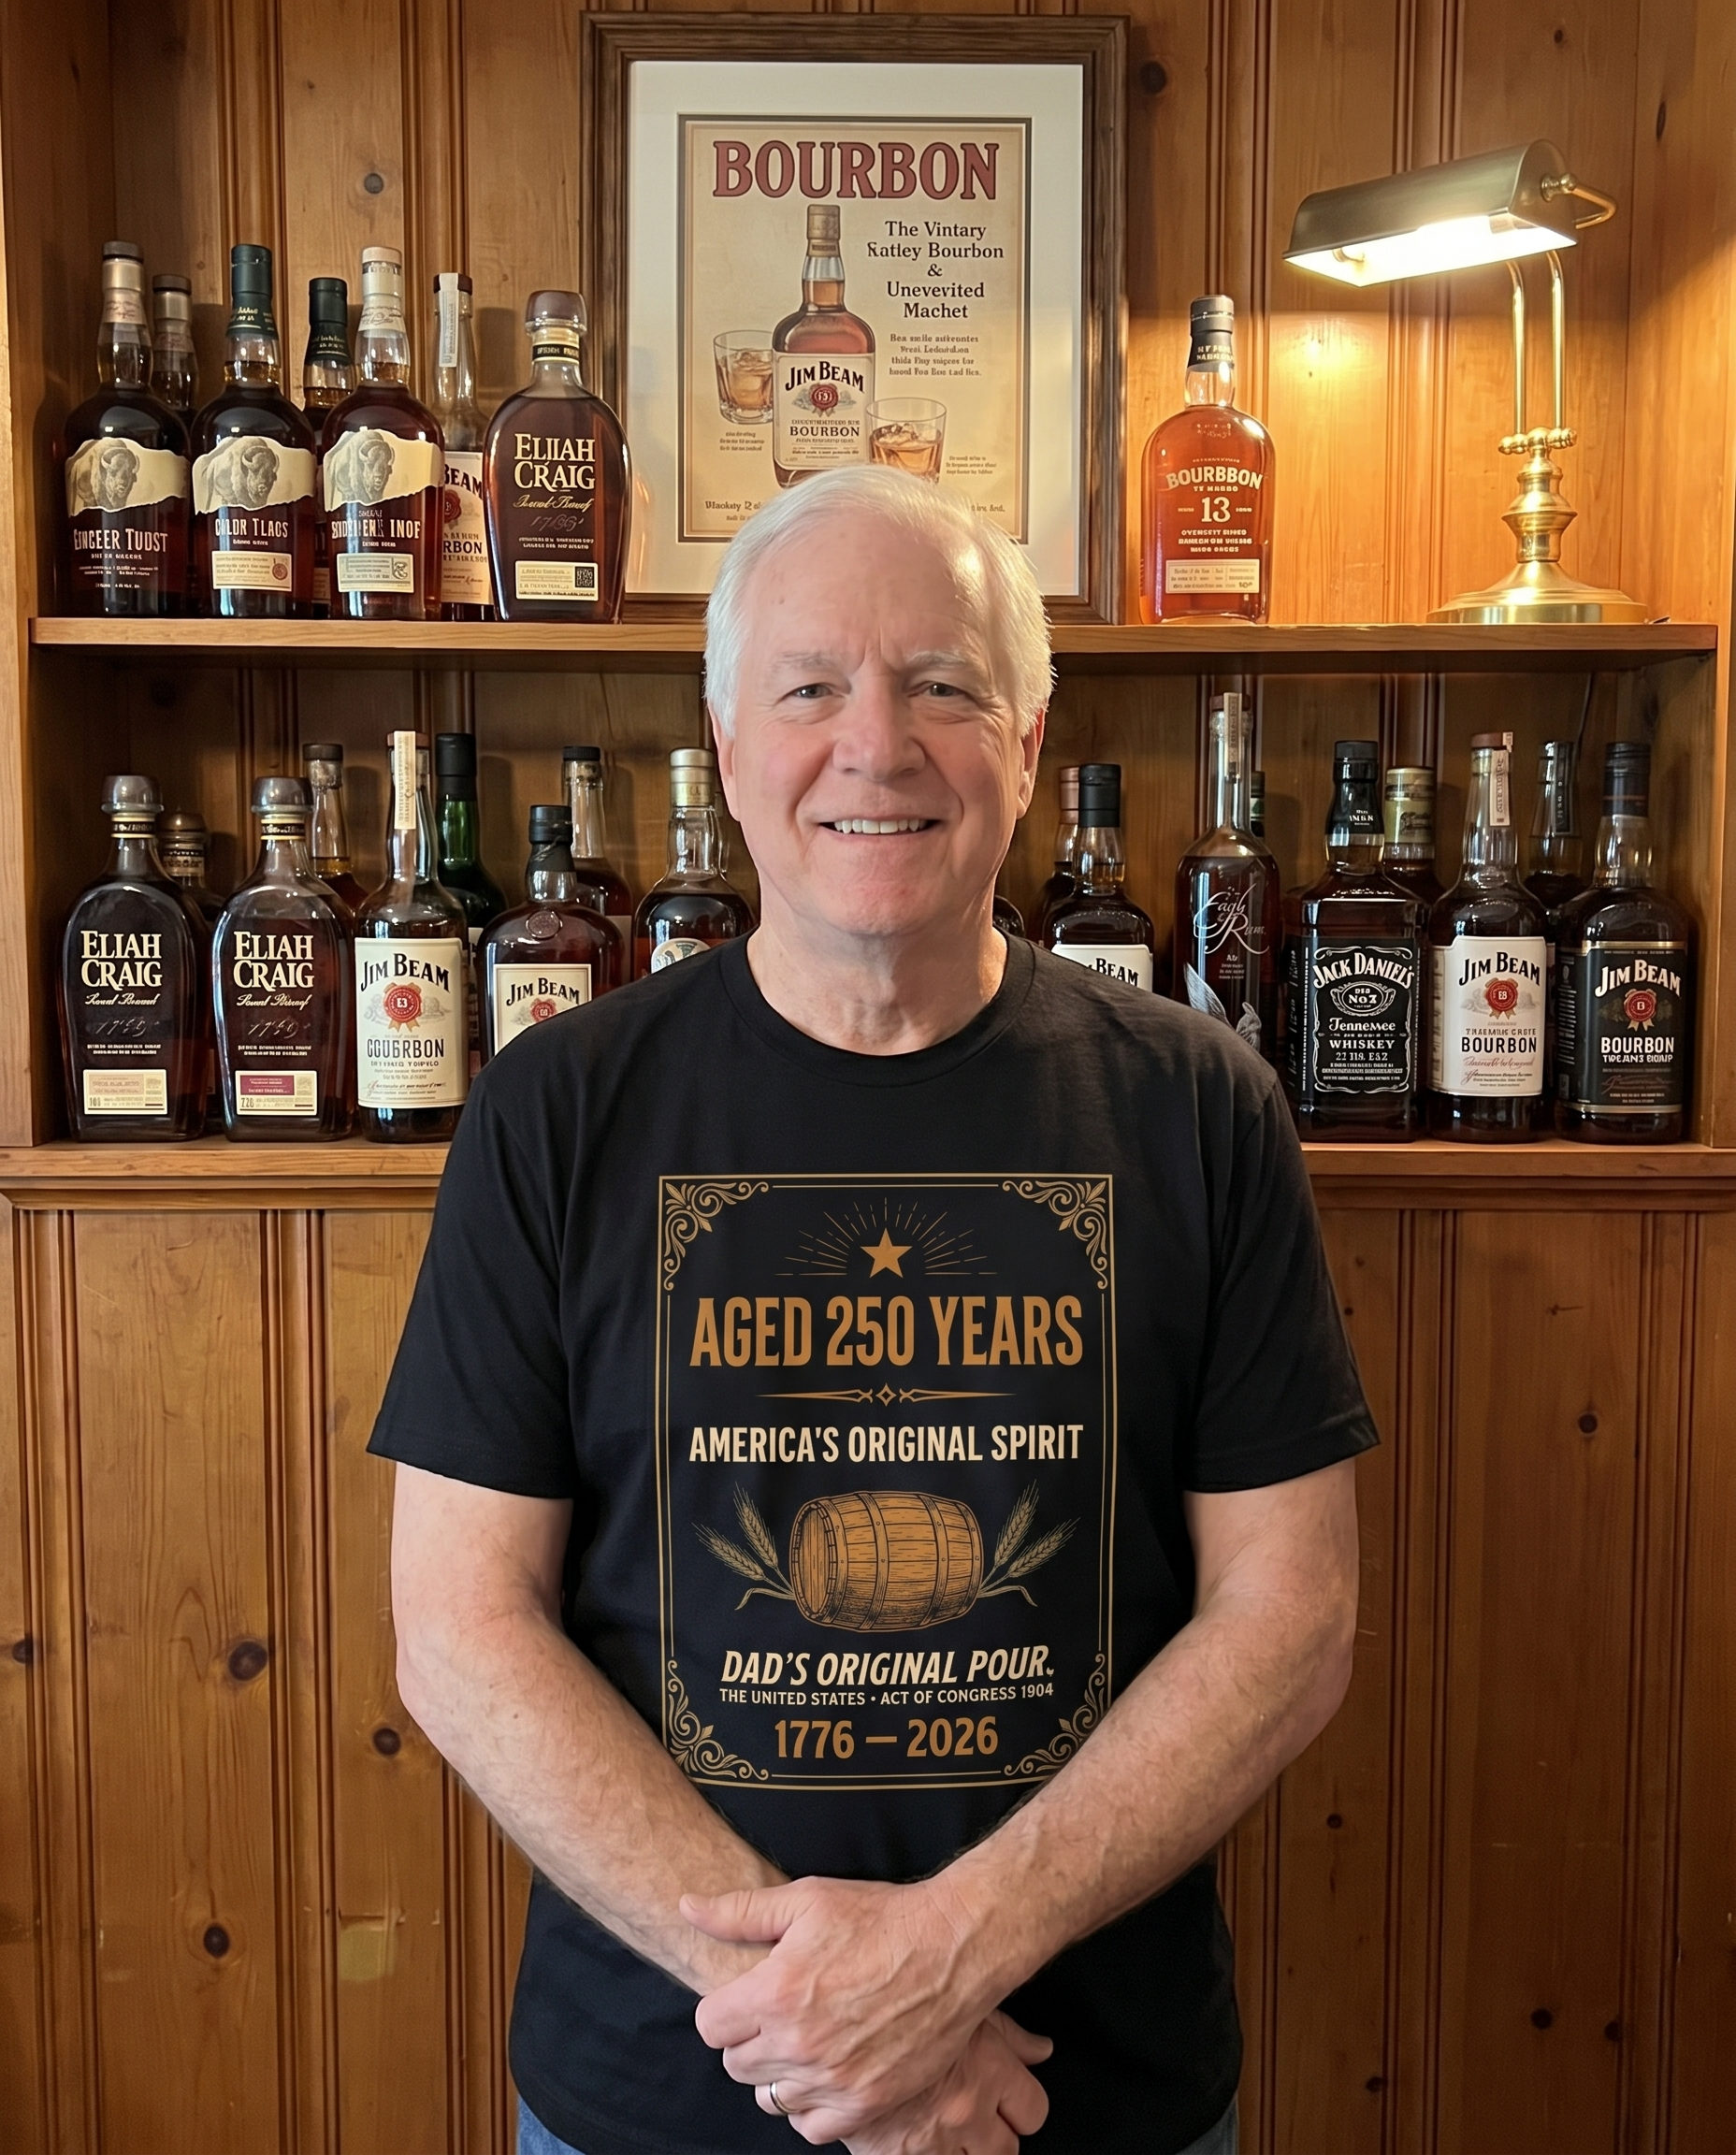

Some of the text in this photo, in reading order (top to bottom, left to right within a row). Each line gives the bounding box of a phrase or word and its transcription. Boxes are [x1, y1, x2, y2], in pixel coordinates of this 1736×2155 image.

[713, 140, 999, 200] BOURBON
[885, 220, 987, 241] The Vintary
[929, 242, 1004, 258] Bourbon
[927, 263, 943, 277] &
[904, 302, 968, 318] Machet
[785, 361, 865, 394] JIM BEAM
[789, 427, 860, 437] BOURBON
[514, 461, 596, 492] CRAIG
[1201, 497, 1231, 522] 13
[80, 959, 163, 991] CRAIG
[233, 960, 315, 991] CRAIG
[360, 953, 451, 993] JIM BEAM
[1095, 958, 1139, 987] BEAM
[1312, 959, 1353, 989] JACK
[1459, 952, 1541, 986] JIM BEAM
[1595, 959, 1682, 998] JIM BEAM
[506, 977, 580, 1006] JIM BEAM
[1329, 1039, 1396, 1049] WHISKEY
[1461, 1037, 1537, 1053] BOURBON
[1600, 1036, 1674, 1053] BOURBON
[689, 1294, 1083, 1367] AGED 250 YEARS
[689, 1425, 1083, 1463] AMERICA'S ORIGINAL SPIRIT
[720, 1650, 811, 1685] DAD’S
[817, 1651, 958, 1686] ORIGINAL
[719, 1687, 747, 1703] THE
[751, 1689, 806, 1705] UNITED
[811, 1692, 865, 1706] STATES
[880, 1691, 909, 1705] ACT
[914, 1690, 933, 1704] OF
[937, 1686, 1017, 1703] CONGRESS
[1020, 1683, 1054, 1699] 1904
[774, 1719, 855, 1759] 1776
[906, 1716, 998, 1757] 2026
